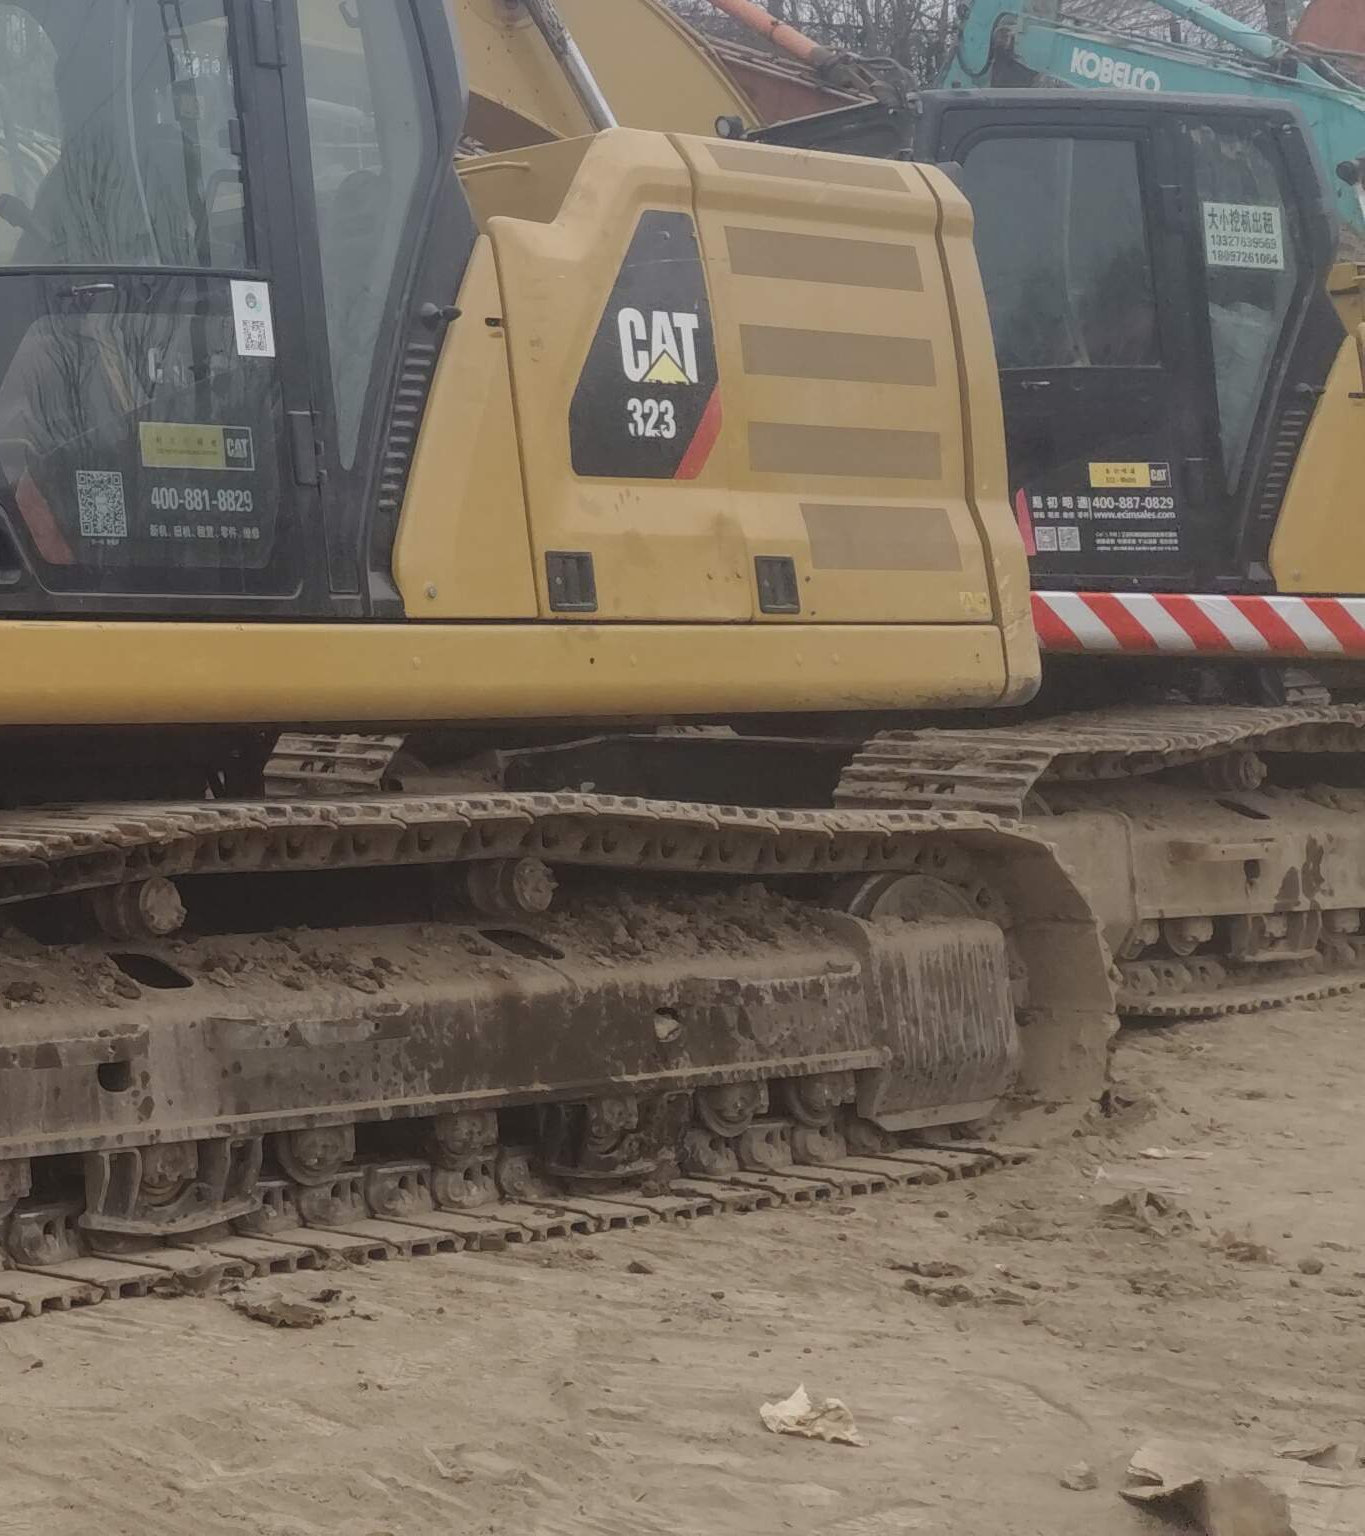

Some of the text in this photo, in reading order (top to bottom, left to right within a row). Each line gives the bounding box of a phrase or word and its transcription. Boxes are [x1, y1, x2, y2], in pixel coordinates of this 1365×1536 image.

[1070, 47, 1161, 91] KOBELCO
[1208, 207, 1274, 234] 大小挖机出租
[619, 307, 700, 384] CAT
[626, 398, 675, 439] 323
[226, 438, 249, 458] CAT
[1150, 469, 1167, 482] CAT
[151, 487, 254, 512] 400-881-8829
[1093, 496, 1174, 509] 400-887-0829
